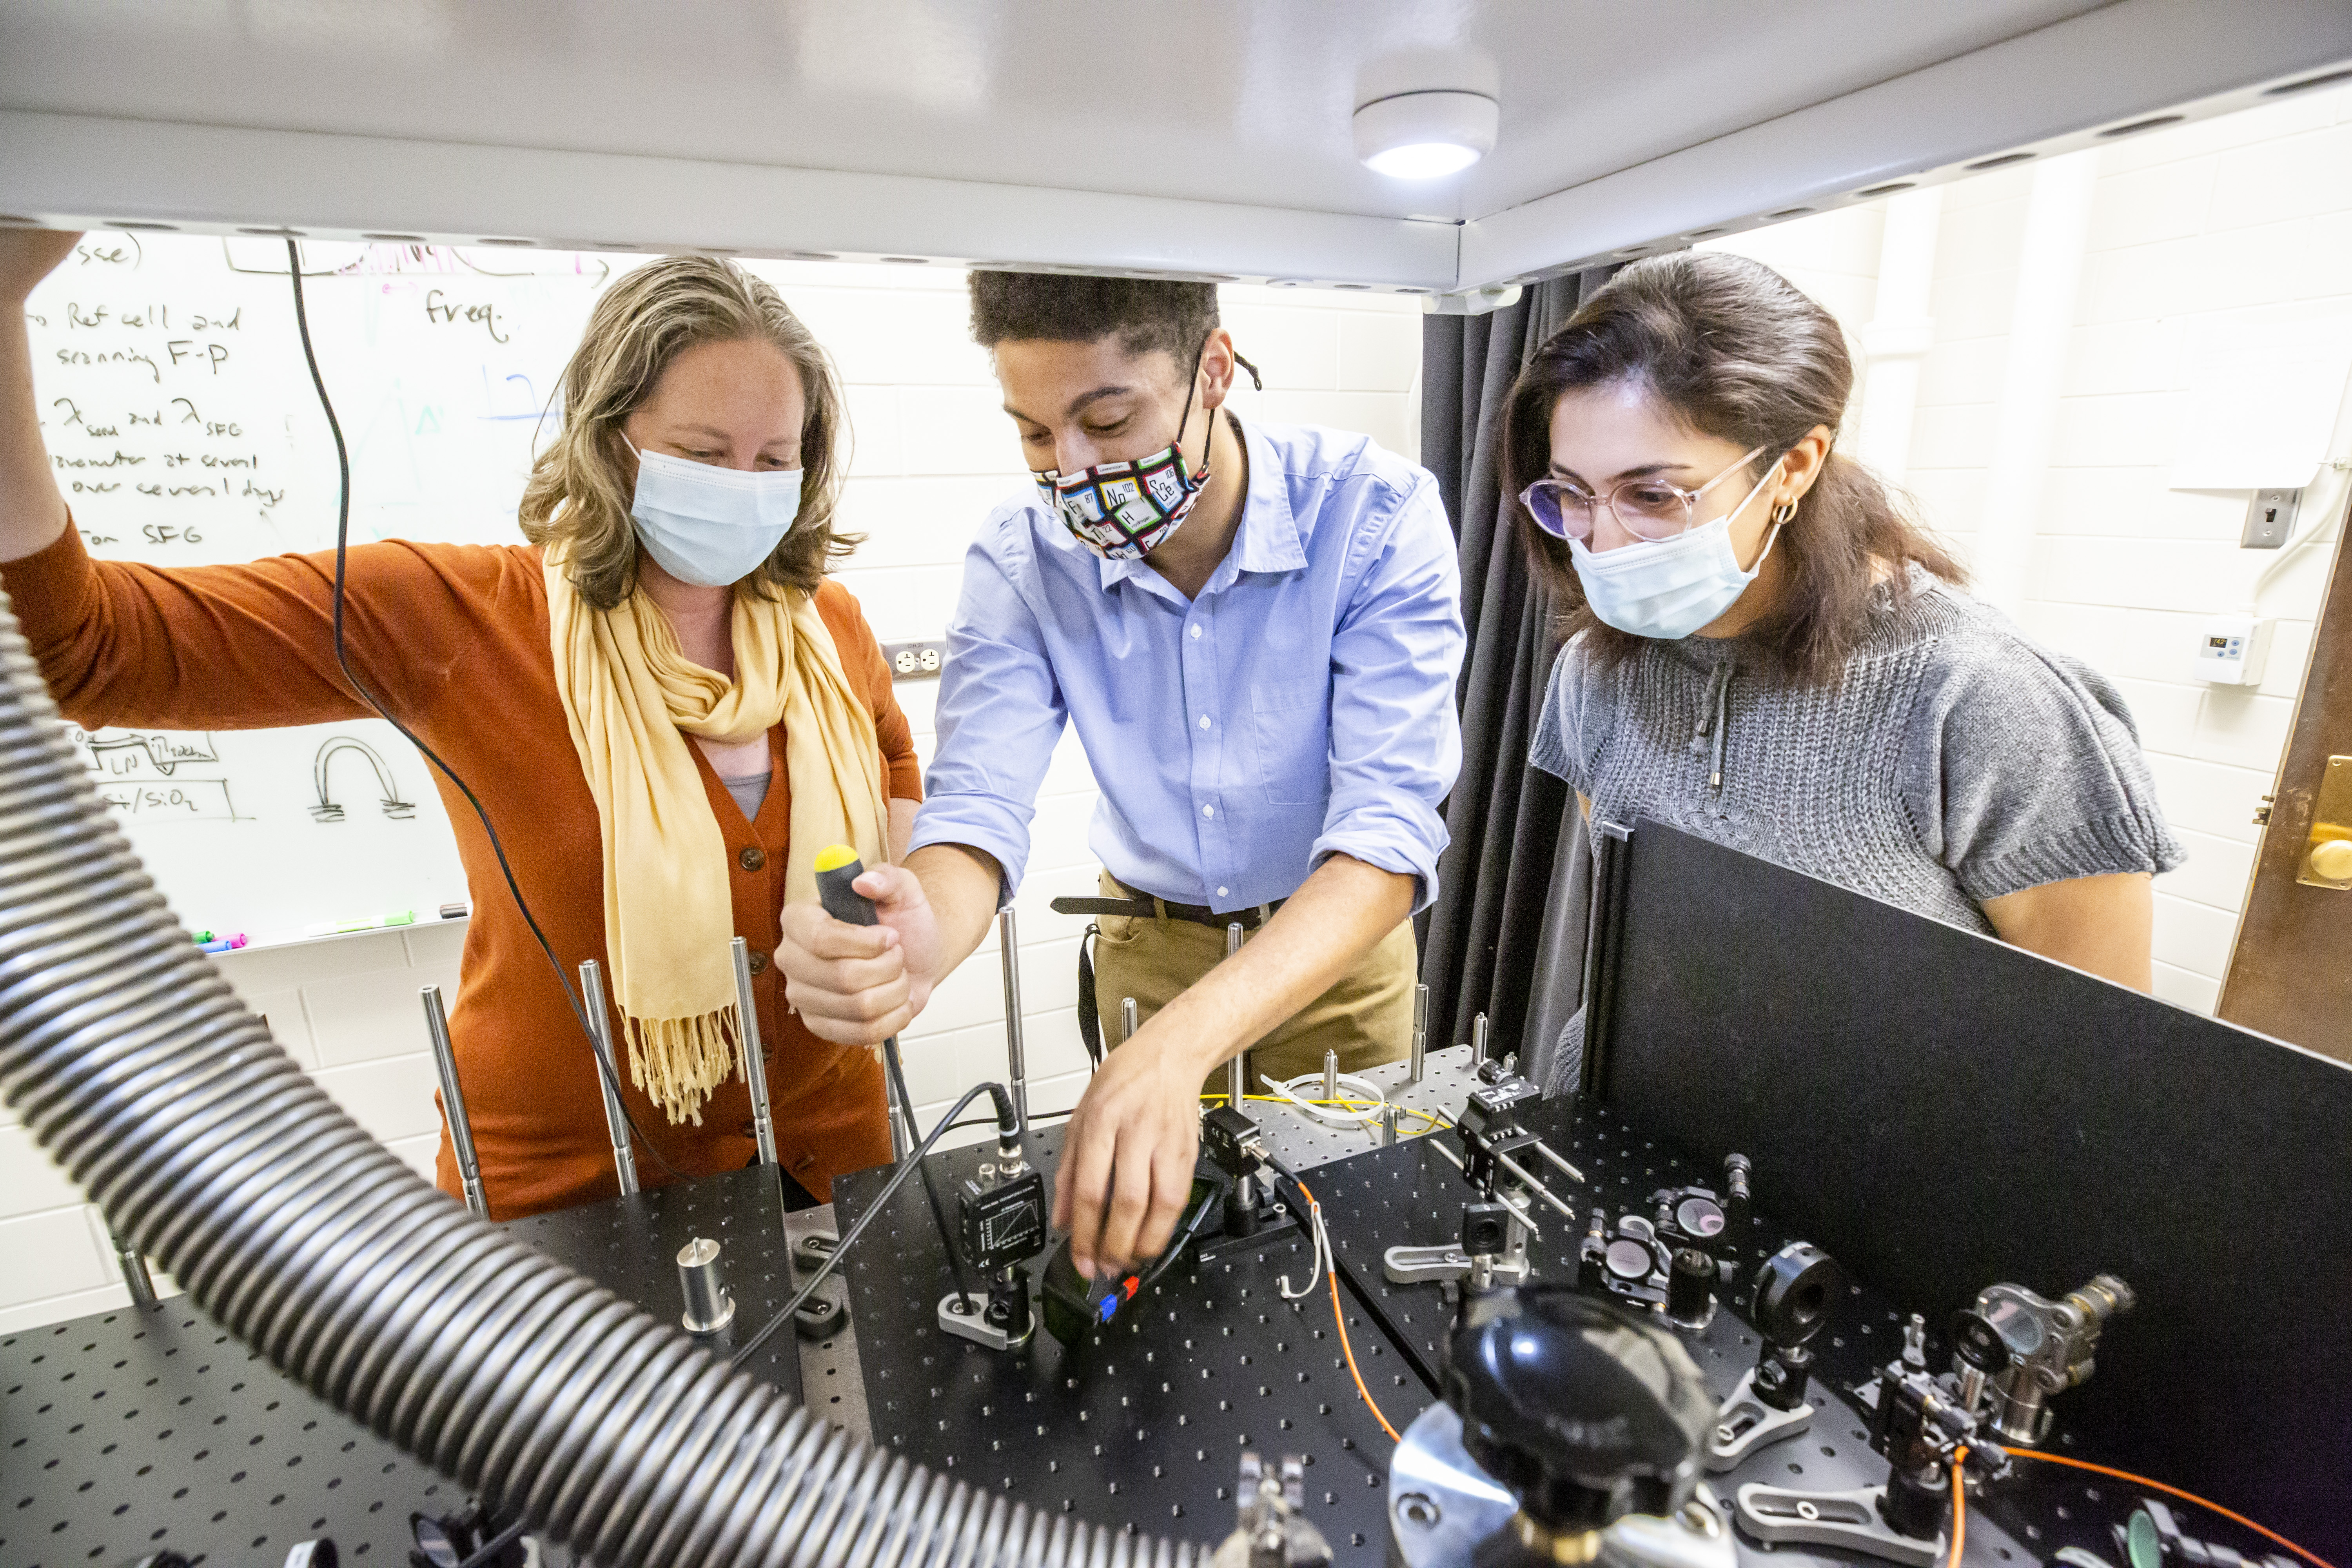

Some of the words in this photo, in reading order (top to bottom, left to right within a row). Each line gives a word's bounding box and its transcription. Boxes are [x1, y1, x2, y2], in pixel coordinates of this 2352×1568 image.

[121, 304, 169, 329] cell
[190, 307, 241, 330] and
[426, 289, 509, 344] freq.
[129, 410, 162, 425] and
[164, 453, 190, 467] at
[72, 481, 121, 493] over
[1122, 483, 1134, 493] 102
[1084, 493, 1093, 504] 87
[1122, 511, 1134, 524] H
[142, 524, 203, 544] SFG
[1103, 524, 1112, 533] 22
[111, 754, 138, 775] LN
